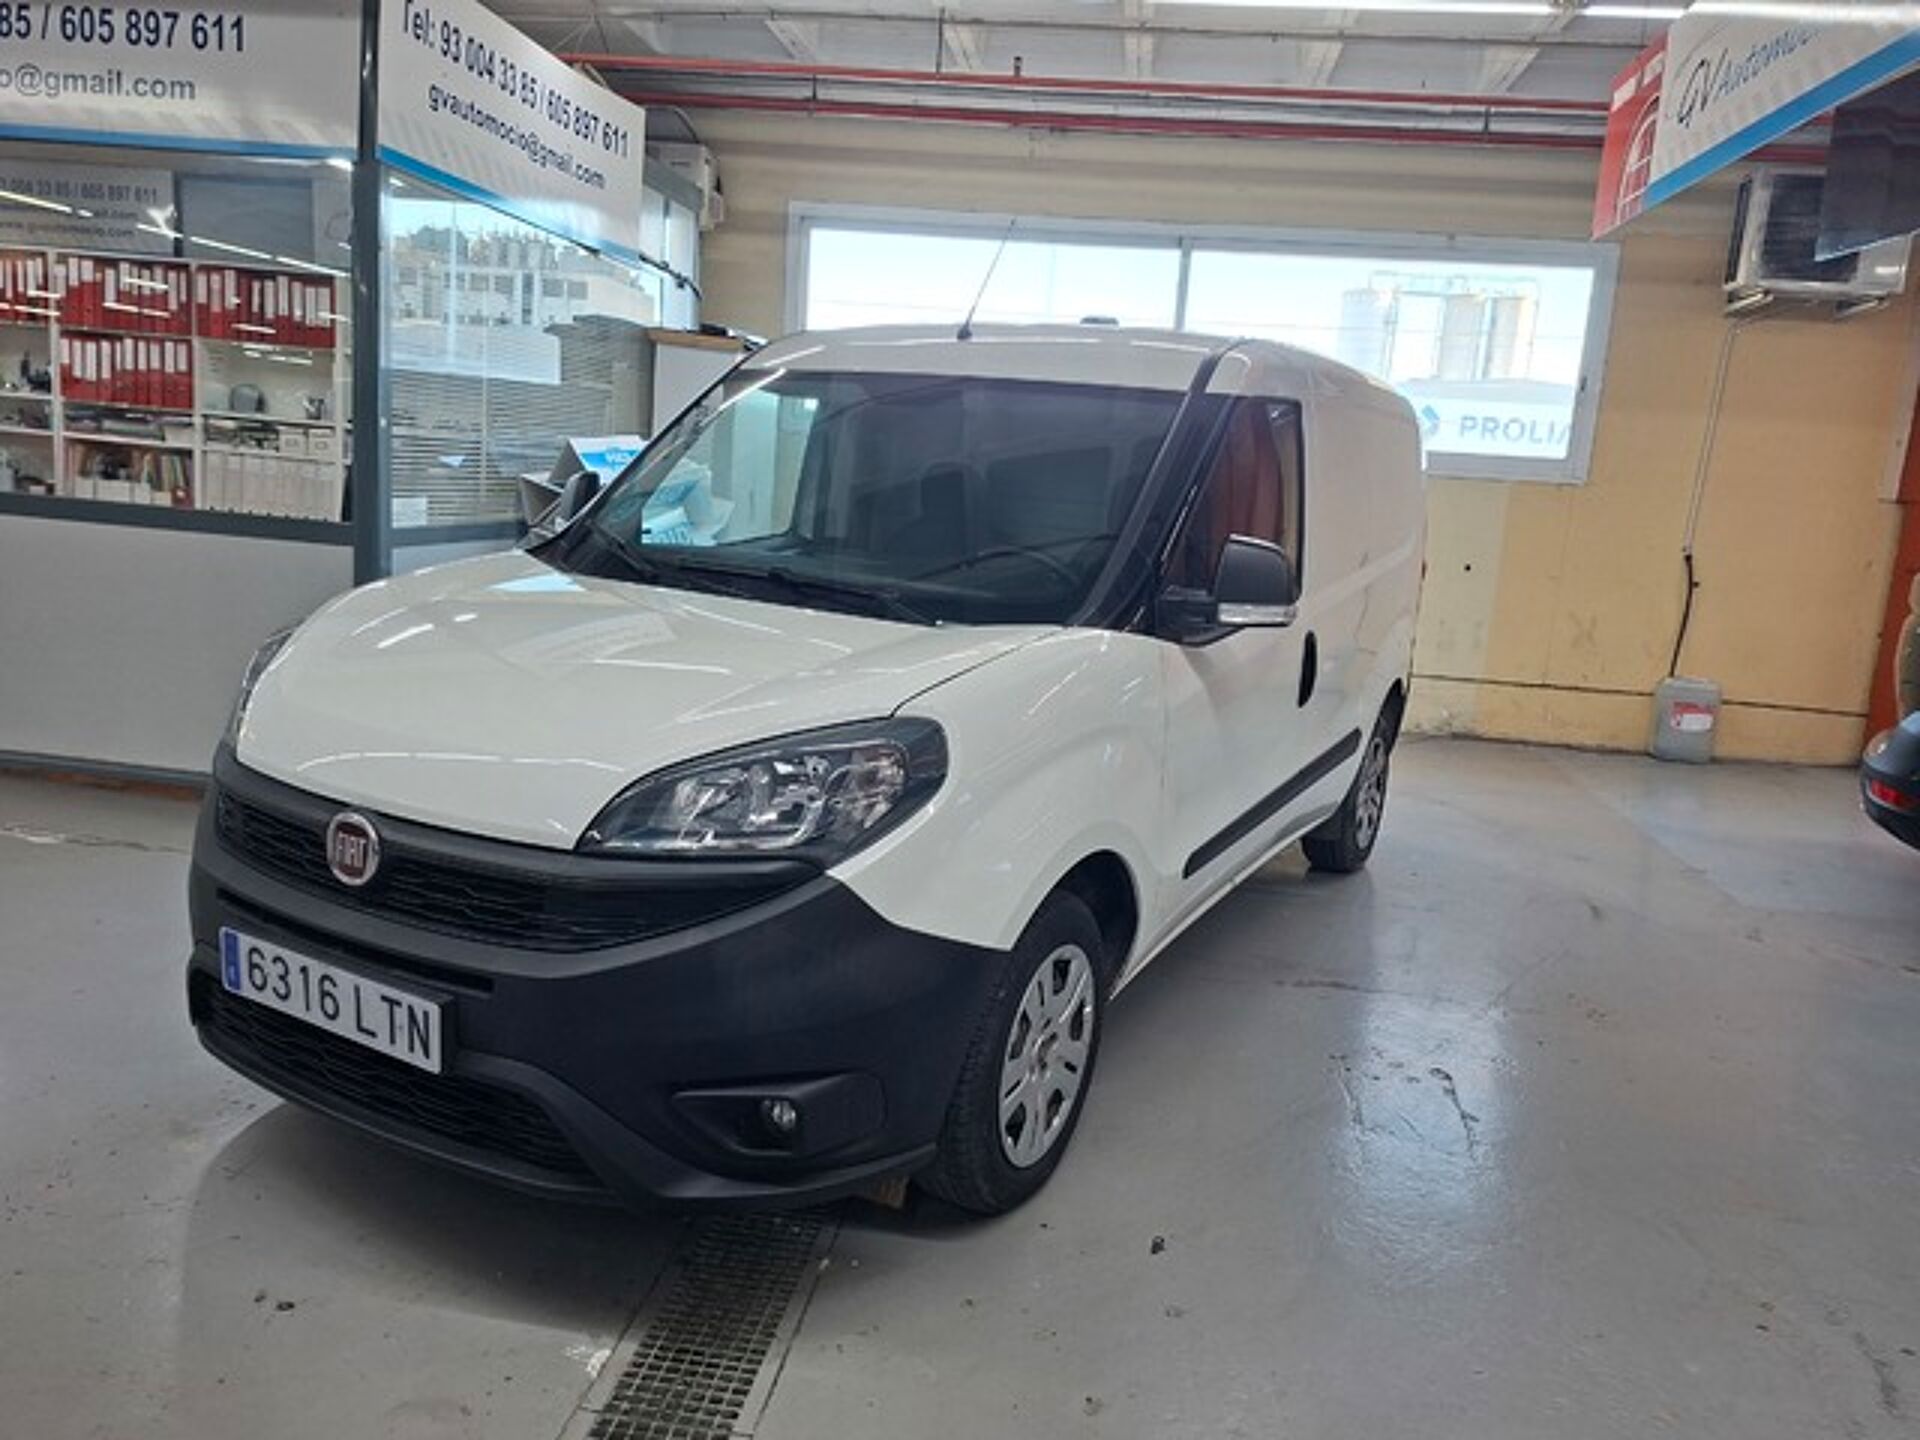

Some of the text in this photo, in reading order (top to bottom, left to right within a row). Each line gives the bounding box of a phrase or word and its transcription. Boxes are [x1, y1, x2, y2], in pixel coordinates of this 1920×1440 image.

[0, 2, 244, 52] 85 / 605 897 611
[401, 0, 436, 48] Tel:
[440, 20, 463, 63] 93
[465, 37, 496, 84] 004
[499, 58, 518, 97] 33
[519, 71, 539, 109] 85
[548, 88, 572, 130] 605
[573, 103, 600, 144] 897
[602, 121, 629, 158] 611
[428, 83, 606, 190] gvautomocio@gmail.com
[335, 830, 367, 868] FIAT
[248, 946, 431, 1060] 6316 LTN
